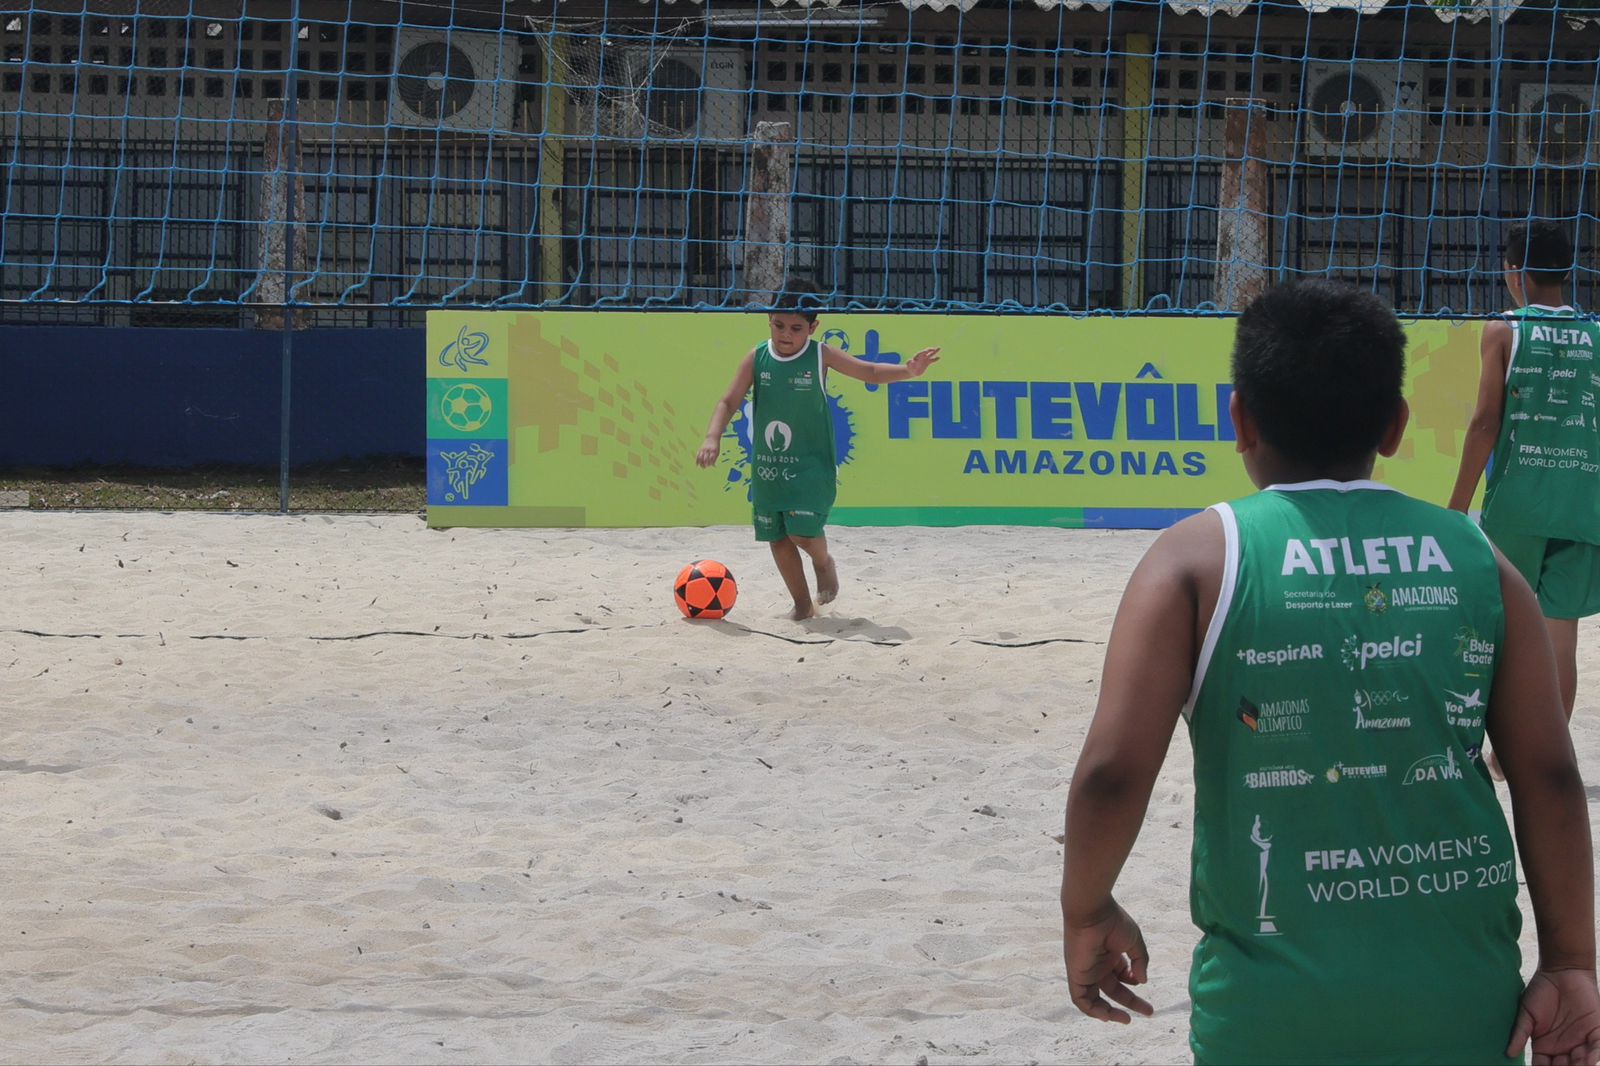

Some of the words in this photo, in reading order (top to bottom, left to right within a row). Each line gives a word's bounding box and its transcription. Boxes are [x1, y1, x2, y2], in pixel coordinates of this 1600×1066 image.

[1530, 325, 1593, 347] ATLETA
[1520, 444, 1542, 454] FIFA
[962, 449, 1207, 477] AMAZONAS
[1518, 456, 1556, 468] WORLD
[1558, 459, 1579, 469] CUP
[1580, 461, 1599, 473] 2027
[1281, 536, 1453, 576] ATLETA
[1284, 590, 1324, 598] Secretaria
[1324, 590, 1336, 598] do
[1392, 586, 1458, 606] AMAZONAS
[1285, 601, 1324, 610] Desporto
[1331, 601, 1353, 609] Lazer
[1236, 644, 1324, 666] +RespirAR
[1260, 698, 1310, 717] AMAZONAS
[1353, 706, 1411, 729] Amazonas
[1249, 769, 1307, 788] BAIRROS
[1415, 766, 1437, 781] DA
[1305, 849, 1364, 871] FIFA
[1368, 835, 1491, 866] WOMEN'S
[1307, 876, 1409, 902] WORLD
[1417, 870, 1469, 894] CUP
[1475, 860, 1513, 888] 2027
